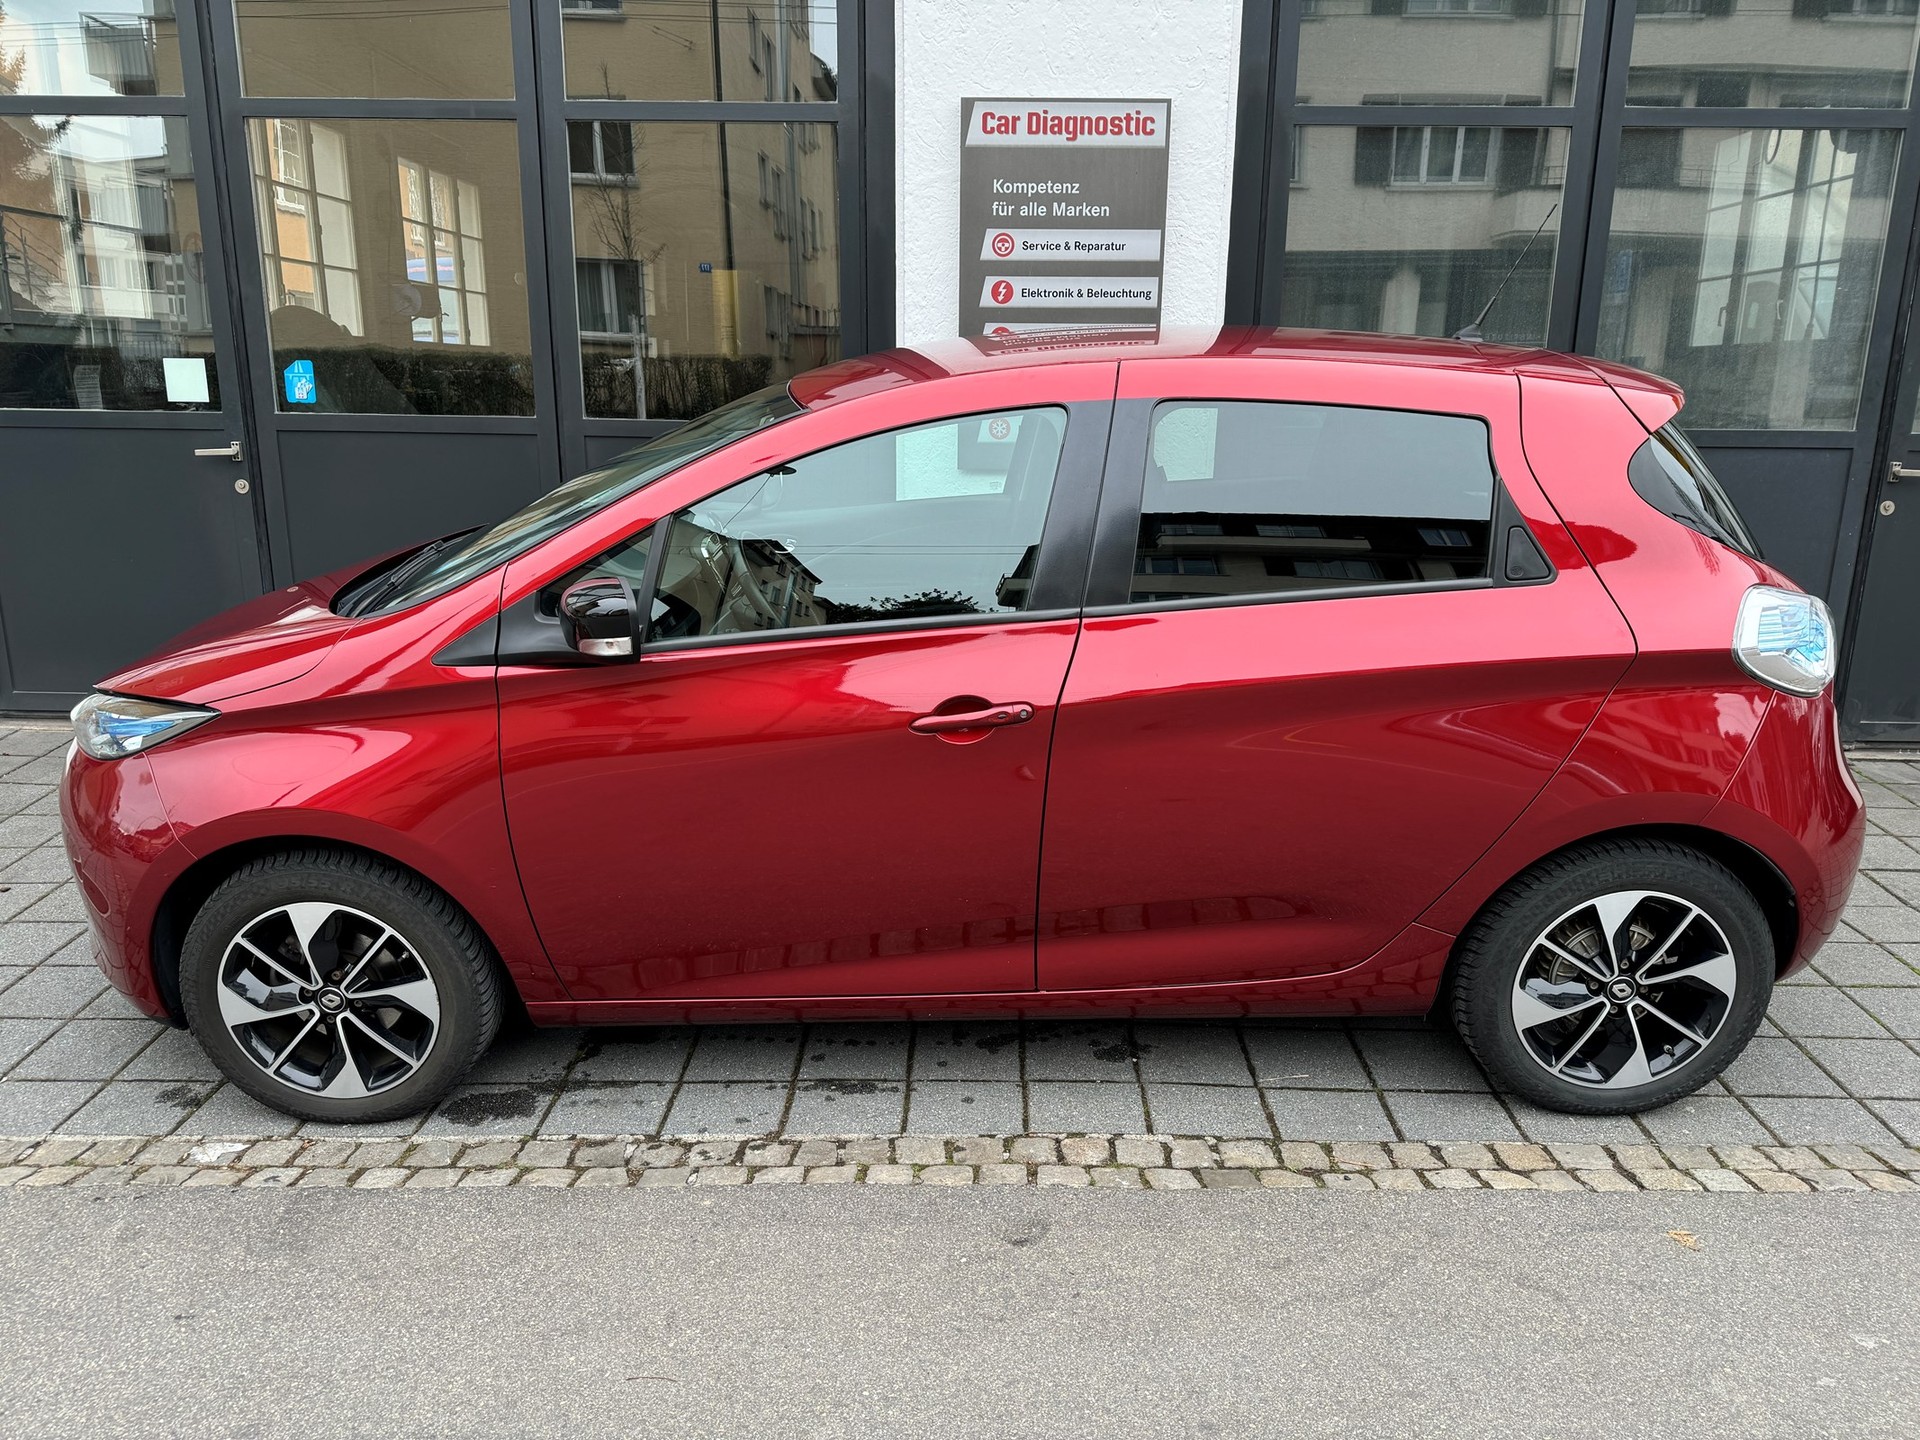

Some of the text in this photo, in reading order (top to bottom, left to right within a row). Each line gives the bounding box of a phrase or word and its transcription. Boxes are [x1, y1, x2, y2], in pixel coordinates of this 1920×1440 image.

[981, 109, 1156, 142] Car Diagnostic
[992, 178, 1080, 198] Kompetenz
[991, 201, 1110, 217] für alle Marken
[1021, 240, 1127, 254] Service & Reparatur
[1020, 287, 1152, 301] Elektronik & Beleuchtung
